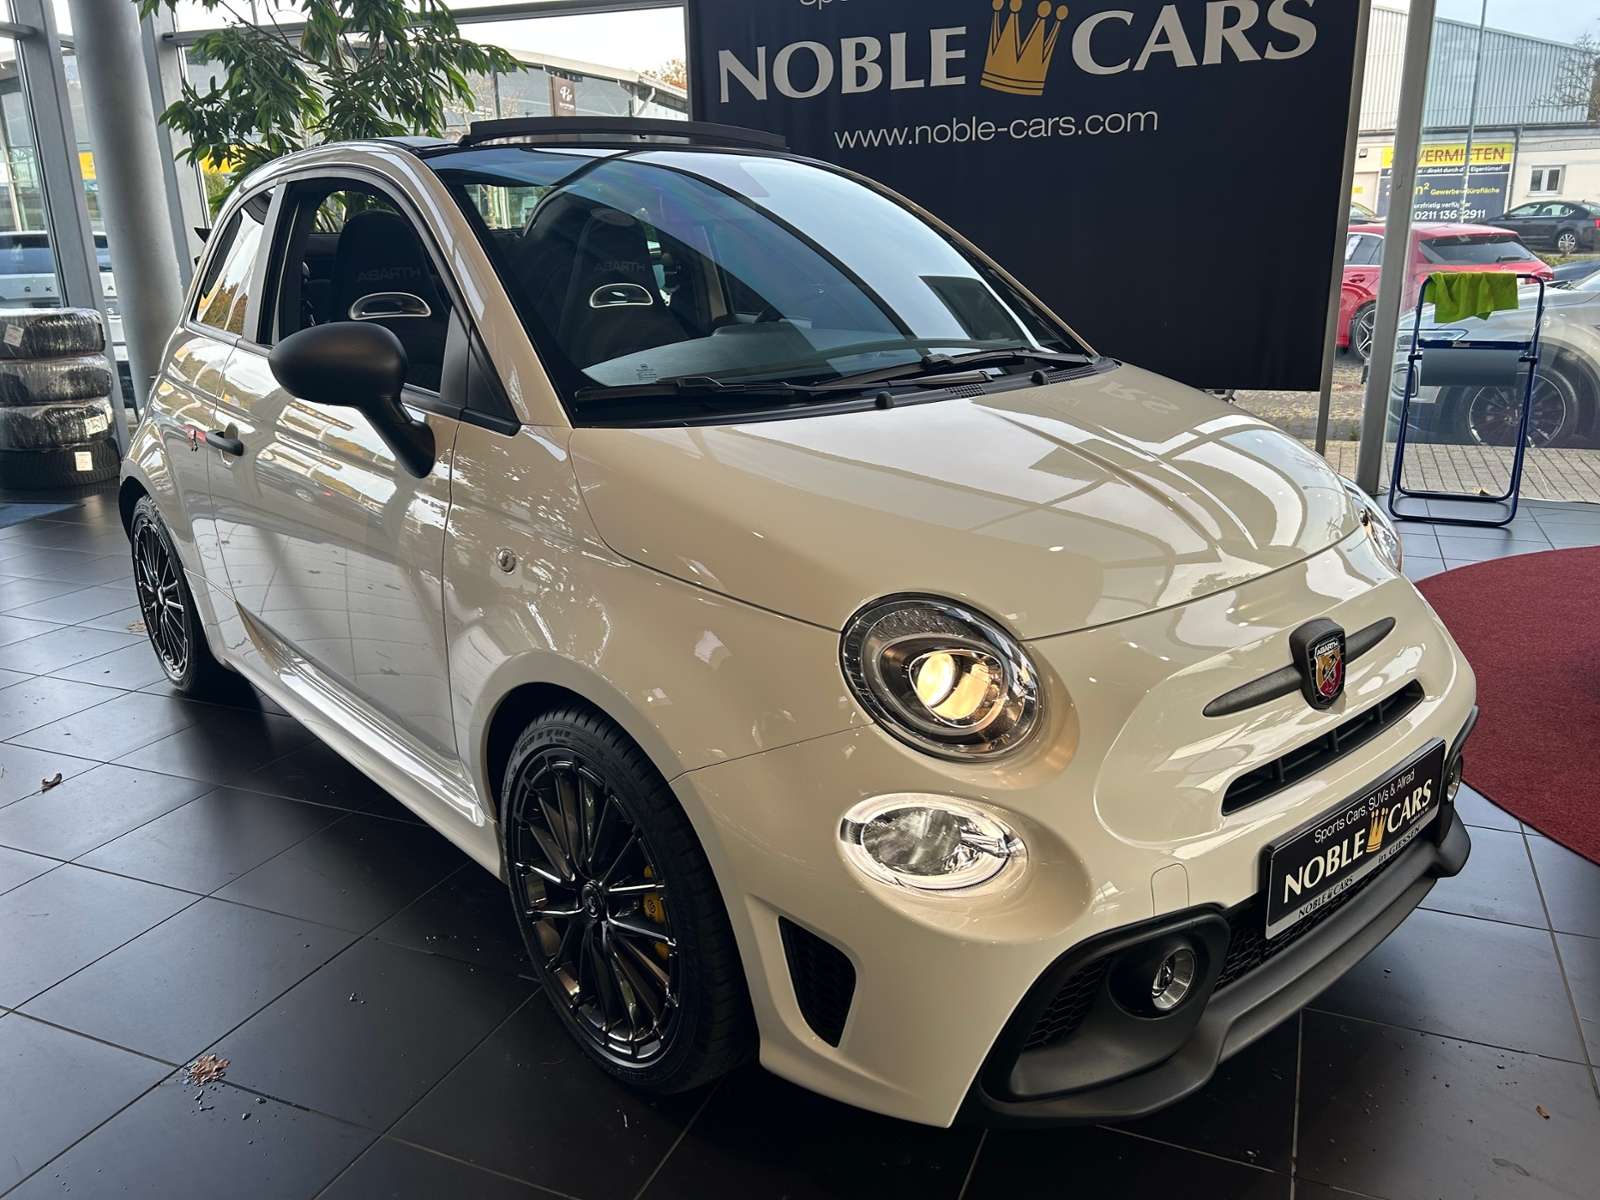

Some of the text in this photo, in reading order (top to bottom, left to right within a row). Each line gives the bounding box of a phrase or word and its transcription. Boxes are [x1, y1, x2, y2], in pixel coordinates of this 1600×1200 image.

[718, 0, 1316, 103] NOBLE CARS
[834, 109, 1159, 149] www.noble-cars.com
[1414, 210, 1437, 220] 0211
[1314, 818, 1345, 844] Sports
[1368, 789, 1389, 810] SUVs
[1390, 783, 1396, 796] &
[1284, 779, 1432, 904] NOBLE CARS
[1298, 875, 1354, 918] NOBLE CARS
